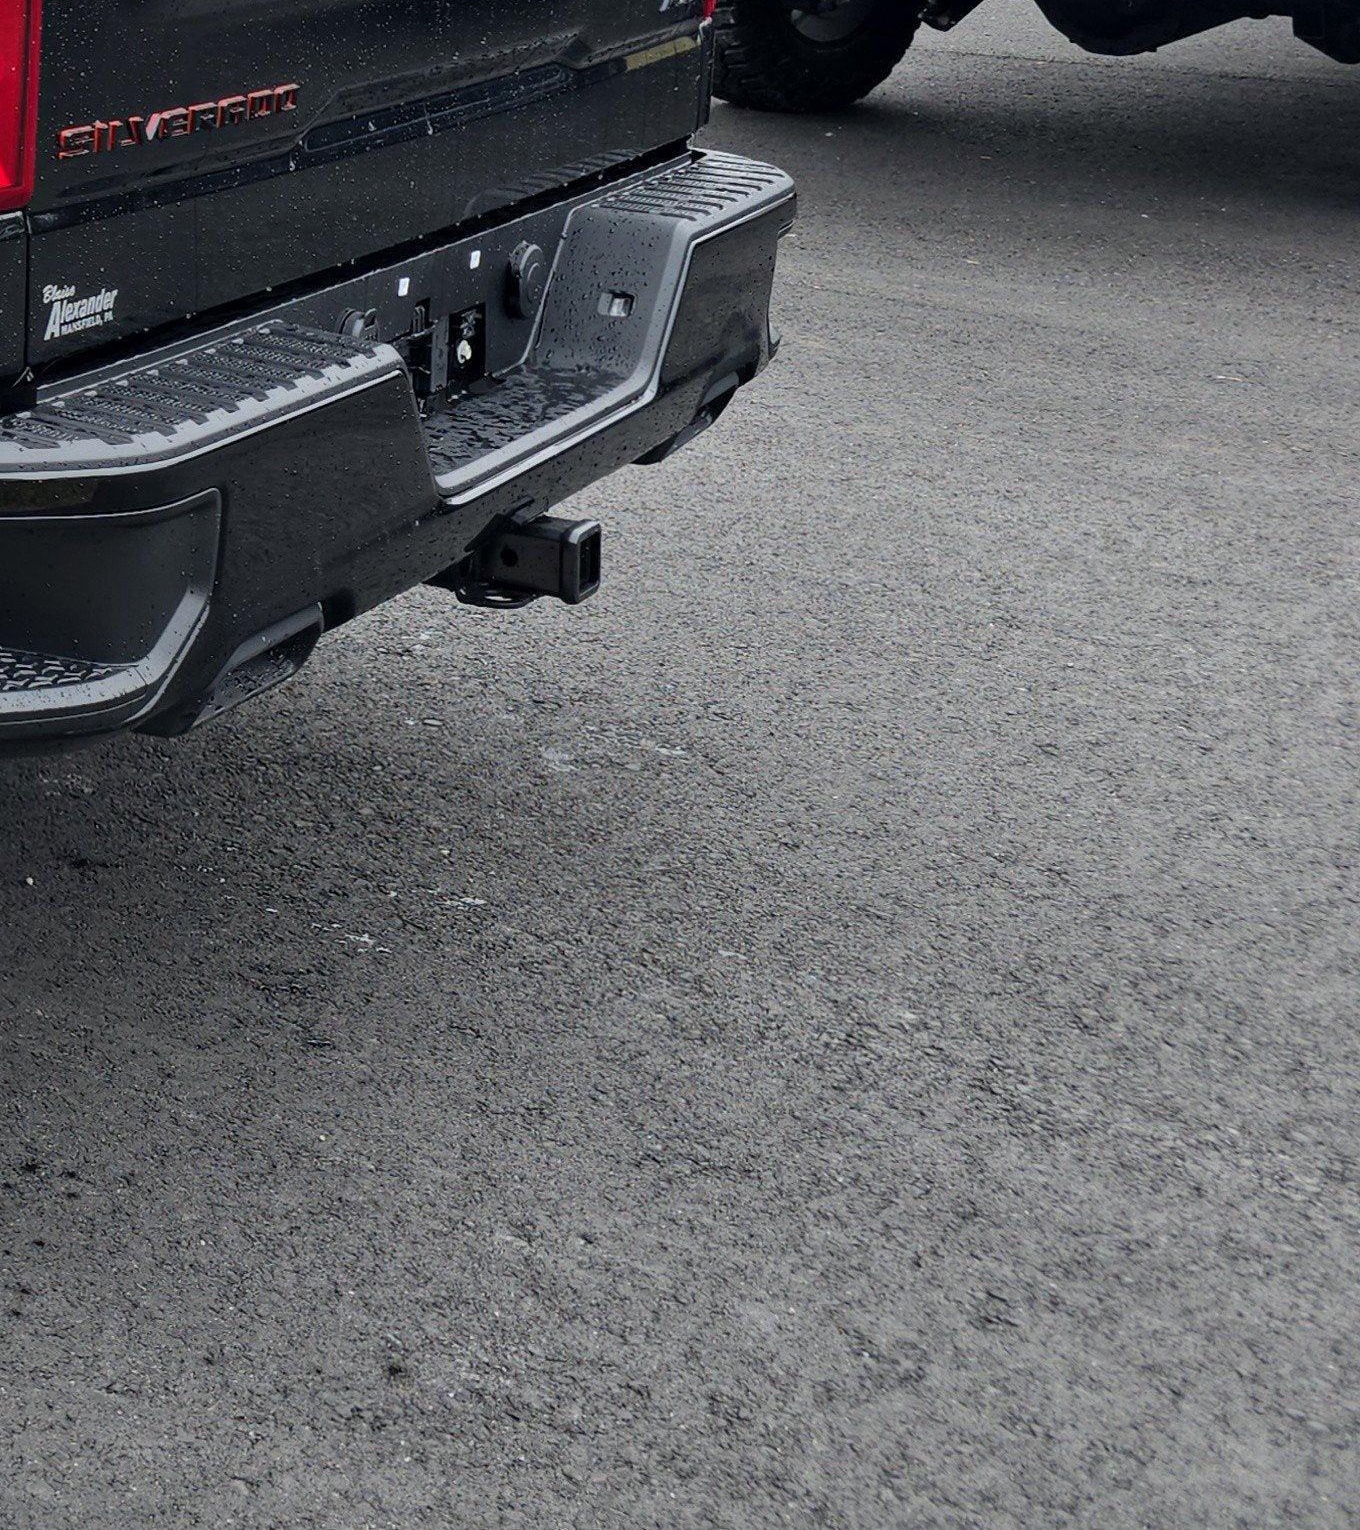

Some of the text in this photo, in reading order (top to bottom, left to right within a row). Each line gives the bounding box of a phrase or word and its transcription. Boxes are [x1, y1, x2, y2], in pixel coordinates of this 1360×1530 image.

[56, 83, 300, 161] SILVERADO
[42, 284, 76, 304] Blaise
[43, 287, 119, 342] Alexander
